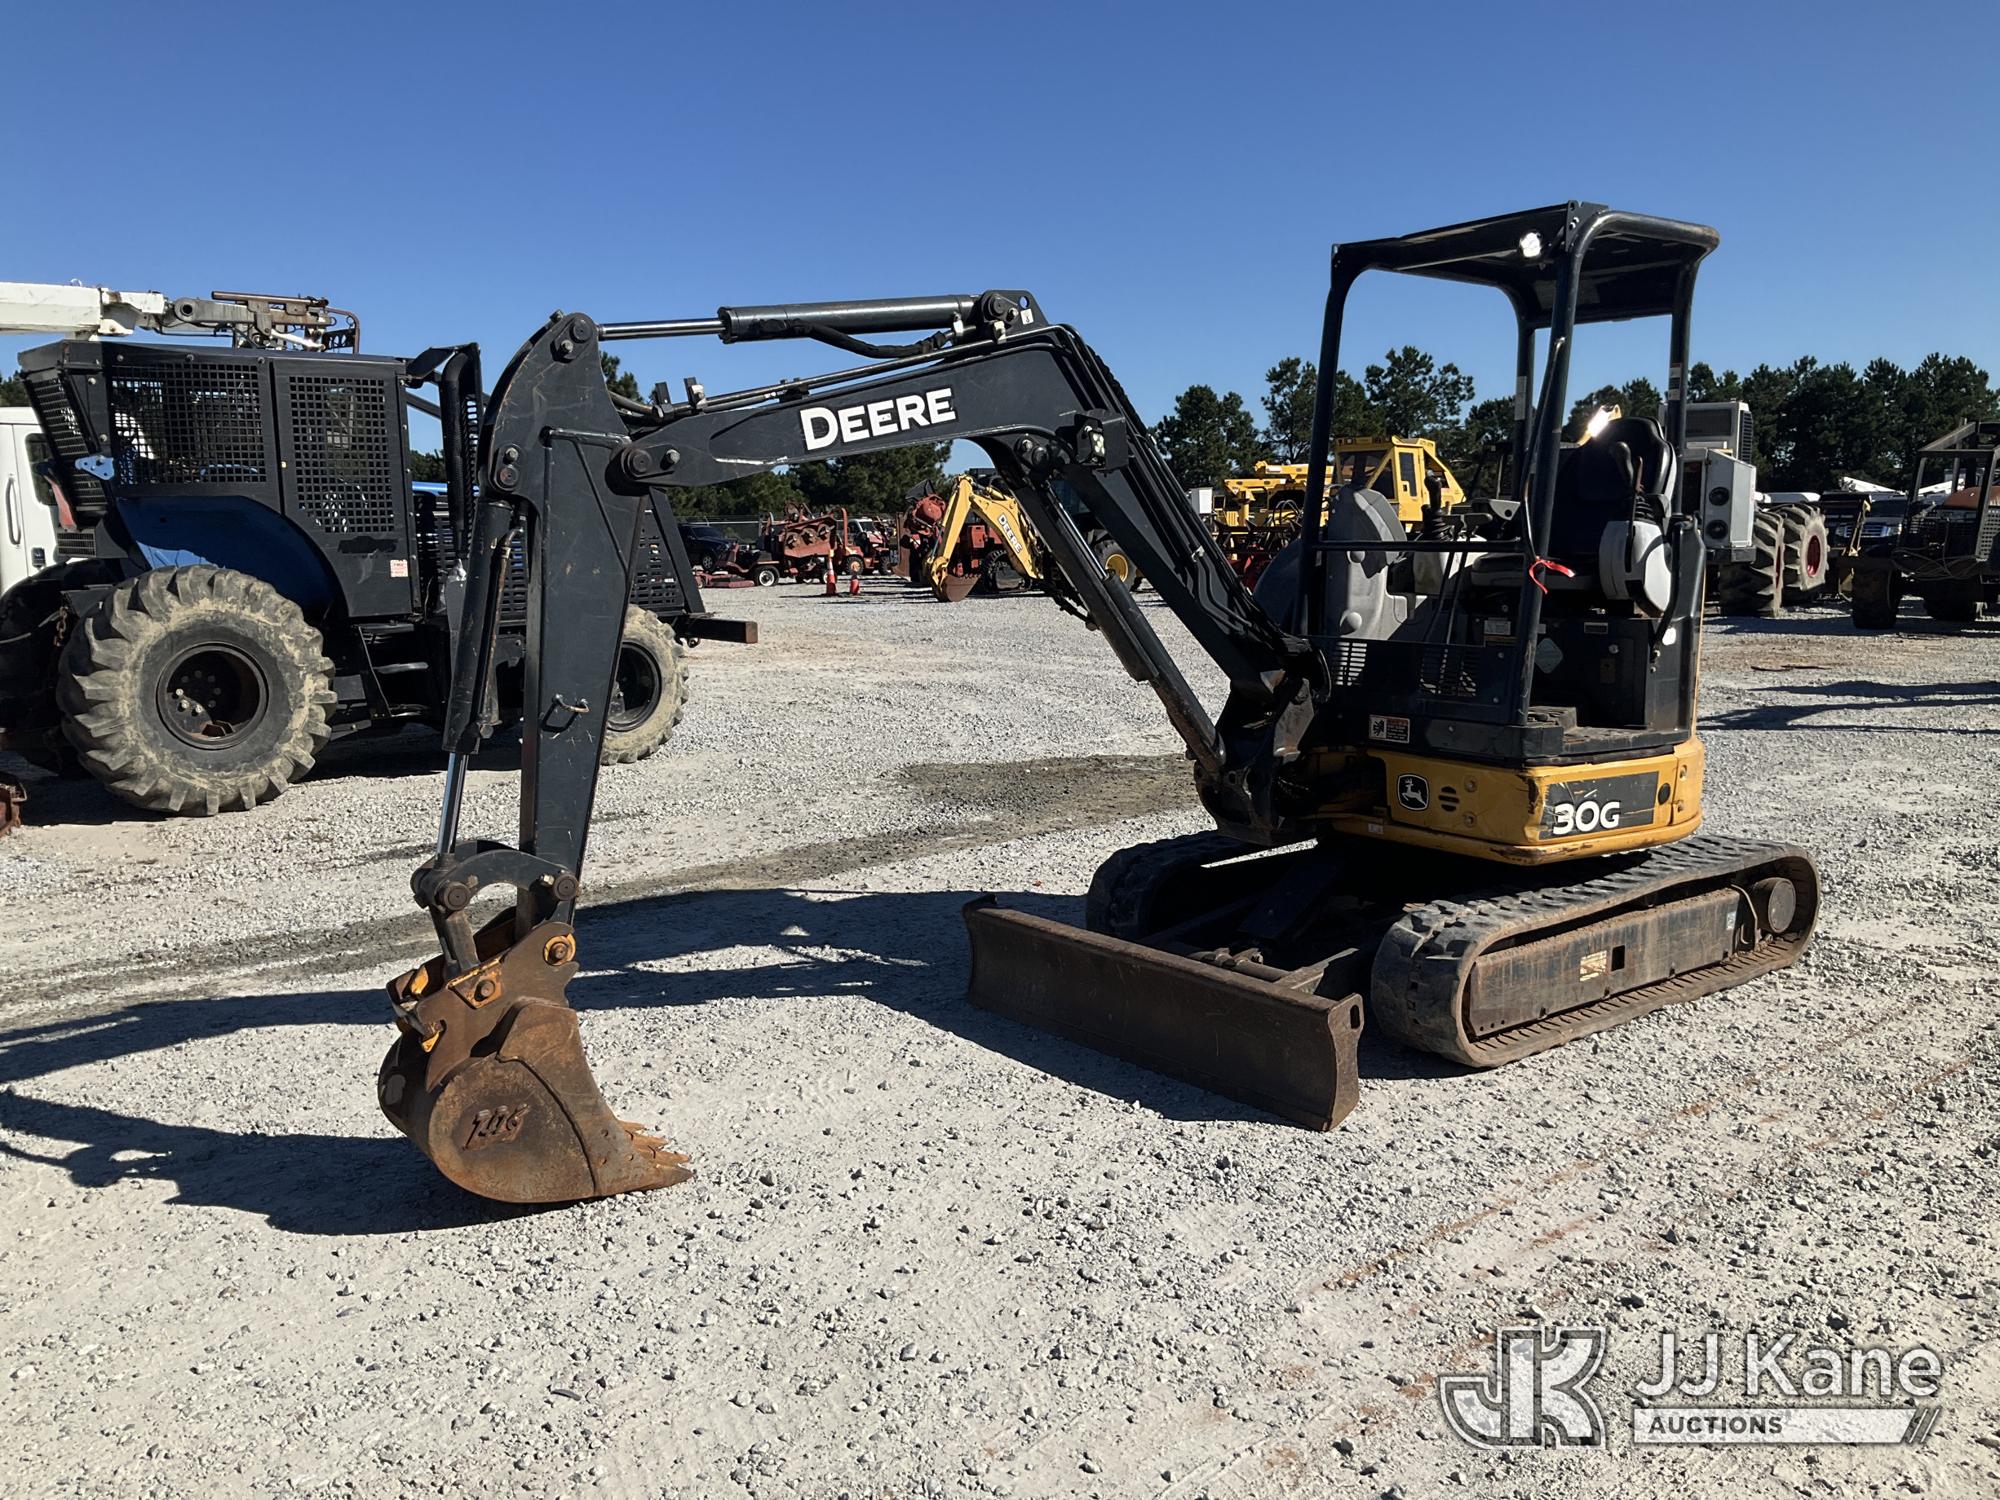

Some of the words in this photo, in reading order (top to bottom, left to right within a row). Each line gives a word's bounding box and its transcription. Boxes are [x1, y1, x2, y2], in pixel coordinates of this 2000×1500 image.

[800, 387, 956, 450] DEERE
[998, 514, 1022, 553] DEERE
[1553, 801, 1620, 835] 30G
